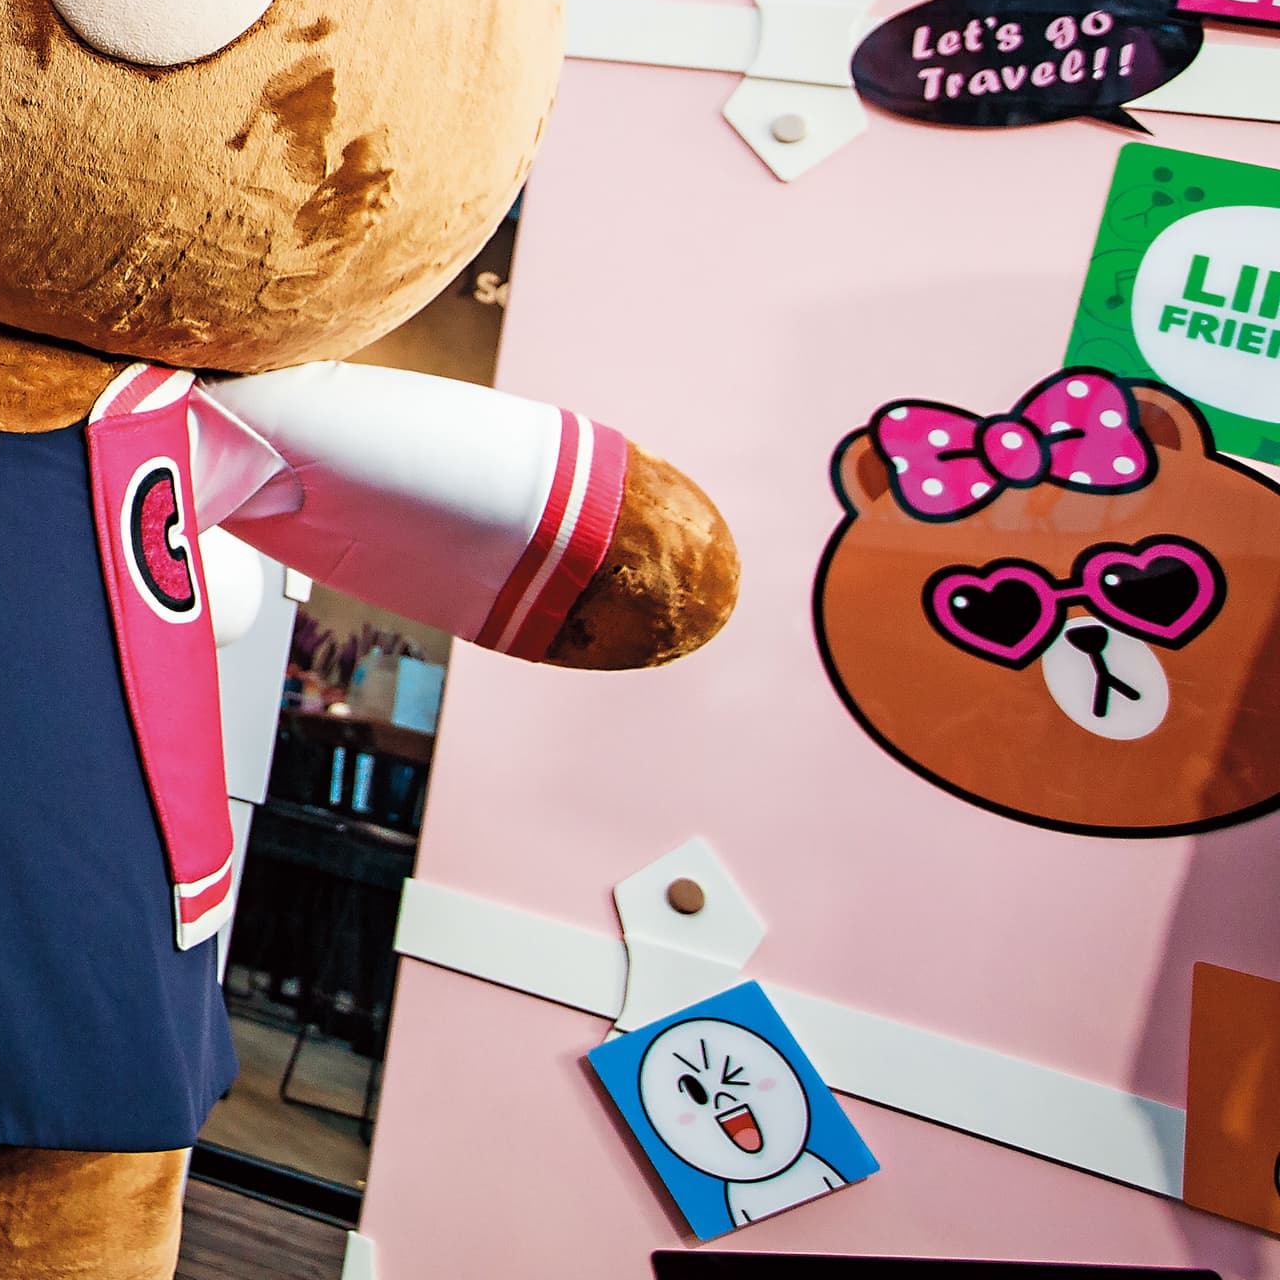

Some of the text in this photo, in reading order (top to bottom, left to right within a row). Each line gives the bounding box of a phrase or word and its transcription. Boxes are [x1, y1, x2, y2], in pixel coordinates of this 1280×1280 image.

[912, 9, 1114, 61] Let's go
[917, 43, 1136, 101] Travel!!
